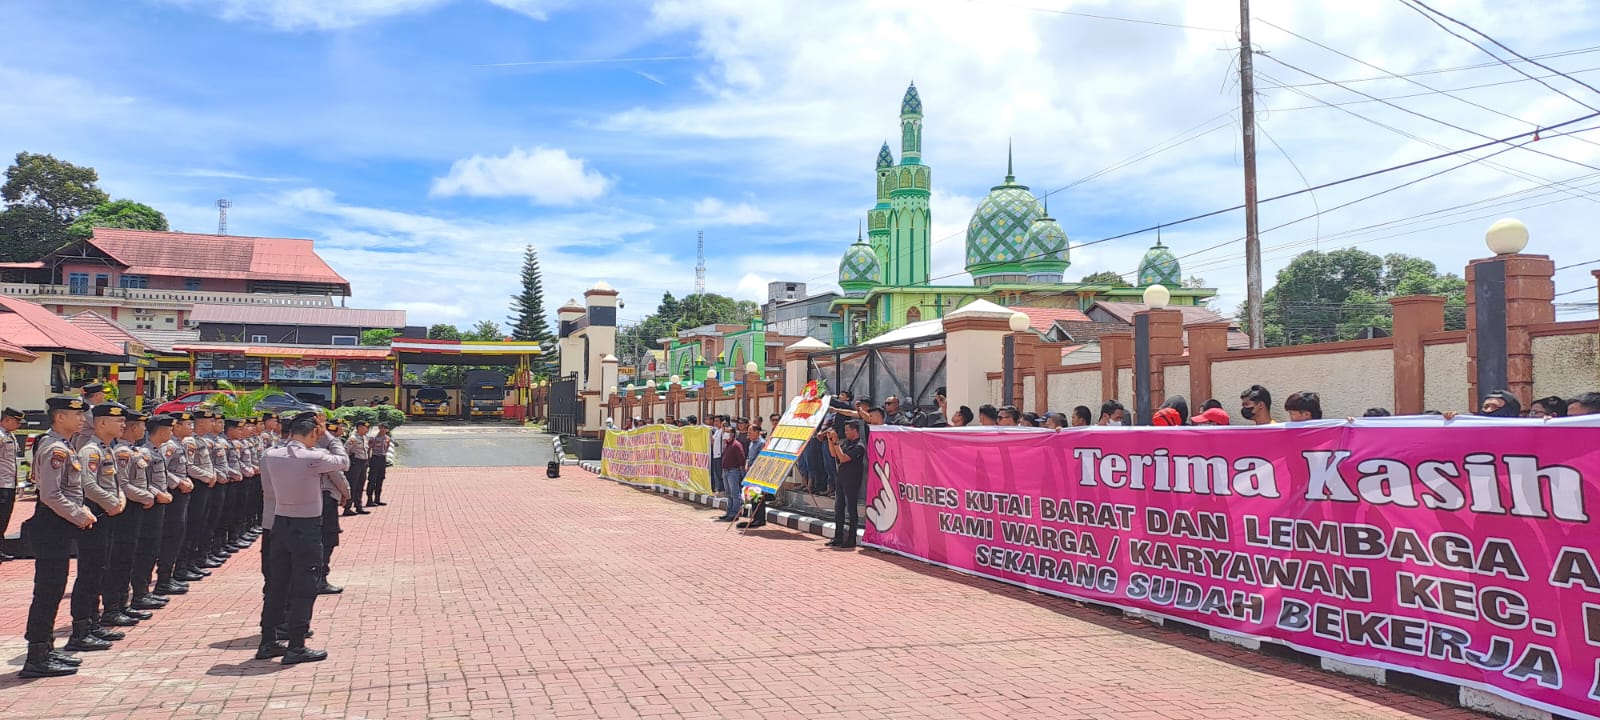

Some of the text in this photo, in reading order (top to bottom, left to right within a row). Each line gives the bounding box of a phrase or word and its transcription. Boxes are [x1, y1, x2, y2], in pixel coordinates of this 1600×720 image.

[899, 482, 959, 508] POLRES
[965, 489, 1032, 518] KUTAI
[1040, 498, 1135, 531] BARAT
[1145, 505, 1229, 542] DAN
[1244, 514, 1528, 582] LEMBAGA
[1074, 448, 1590, 523] Terima Kasih
[939, 513, 994, 540] KAMI
[1002, 521, 1101, 559] WARGA
[1109, 537, 1119, 562] /
[1129, 538, 1372, 601] KARYAWAN
[1397, 572, 1557, 637] KEC.
[976, 545, 1118, 594] SEKARANG
[1127, 573, 1265, 624] SUDAH
[1277, 599, 1562, 689] BEKERJA
